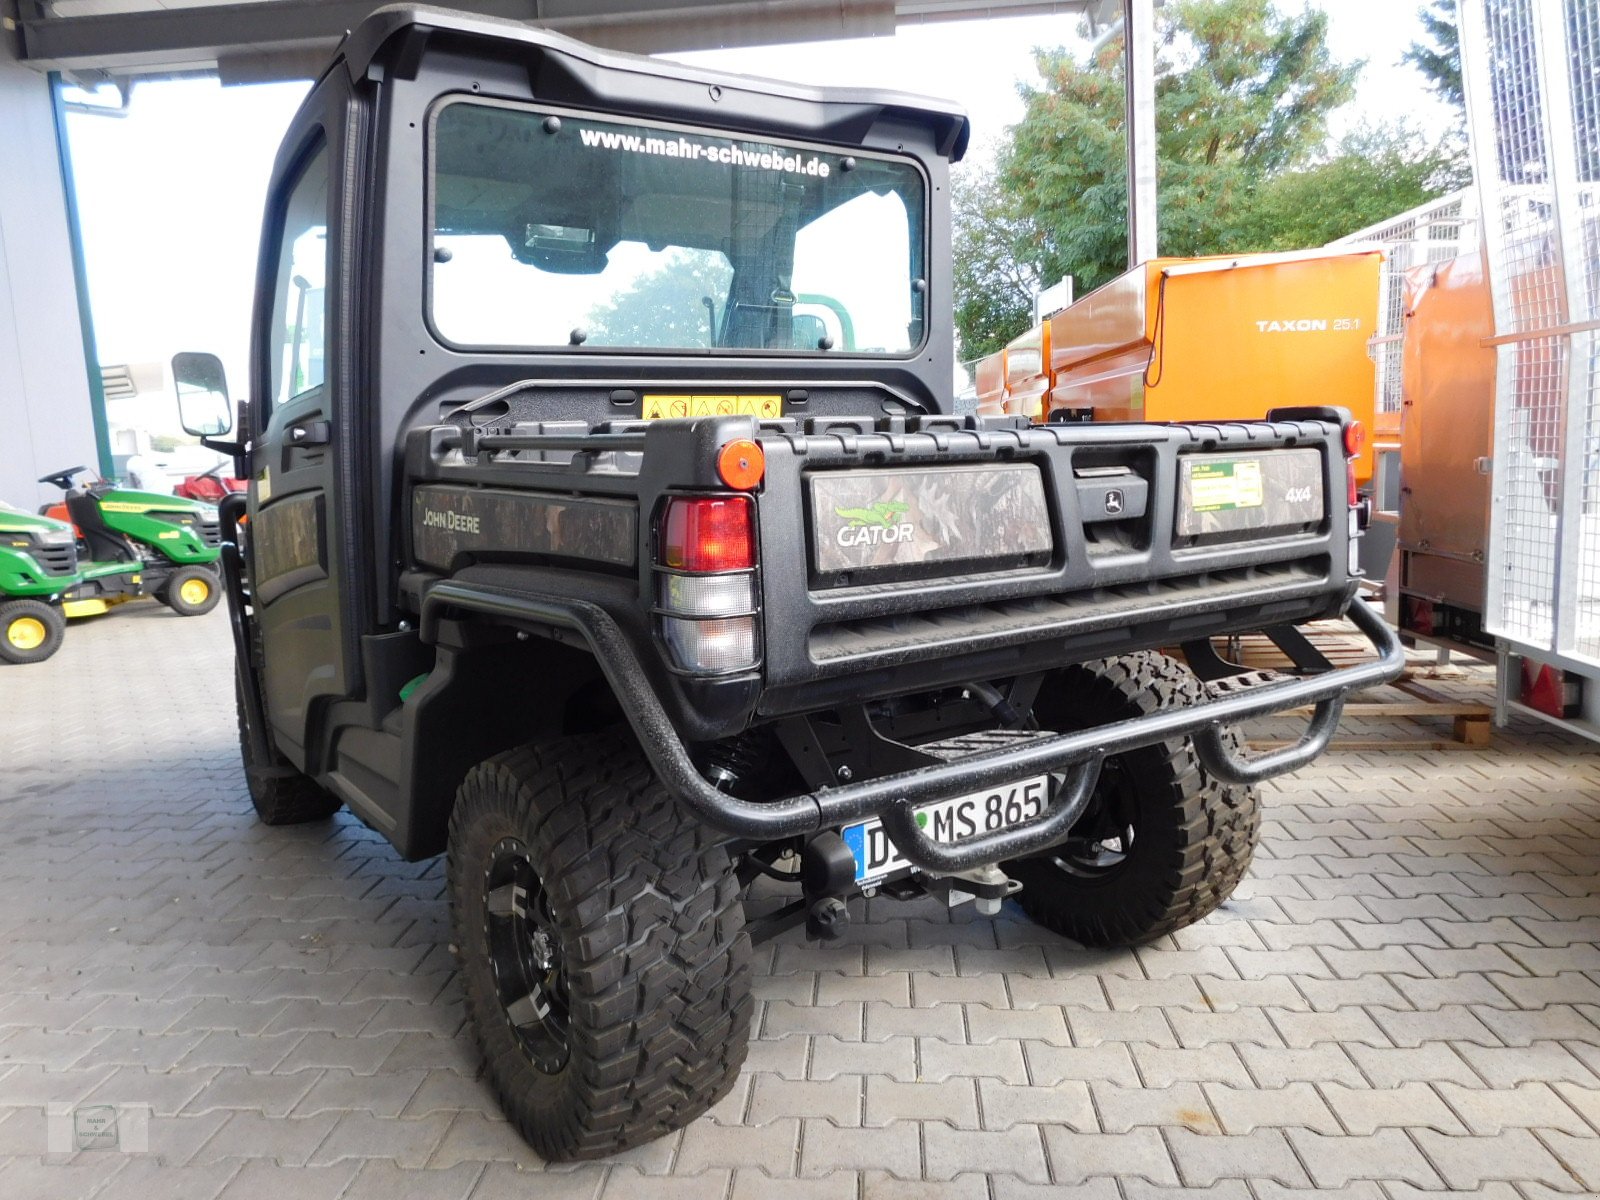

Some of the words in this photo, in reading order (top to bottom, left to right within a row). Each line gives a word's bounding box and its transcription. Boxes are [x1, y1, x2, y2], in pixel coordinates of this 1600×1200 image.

[579, 128, 831, 178] www.mahr-schwebel.de
[1256, 319, 1327, 332] TAXON
[423, 507, 447, 529] JOHN
[447, 510, 480, 534] DEERE
[836, 522, 914, 547] GATOR
[934, 801, 977, 843] MS
[985, 782, 1042, 831] 865
